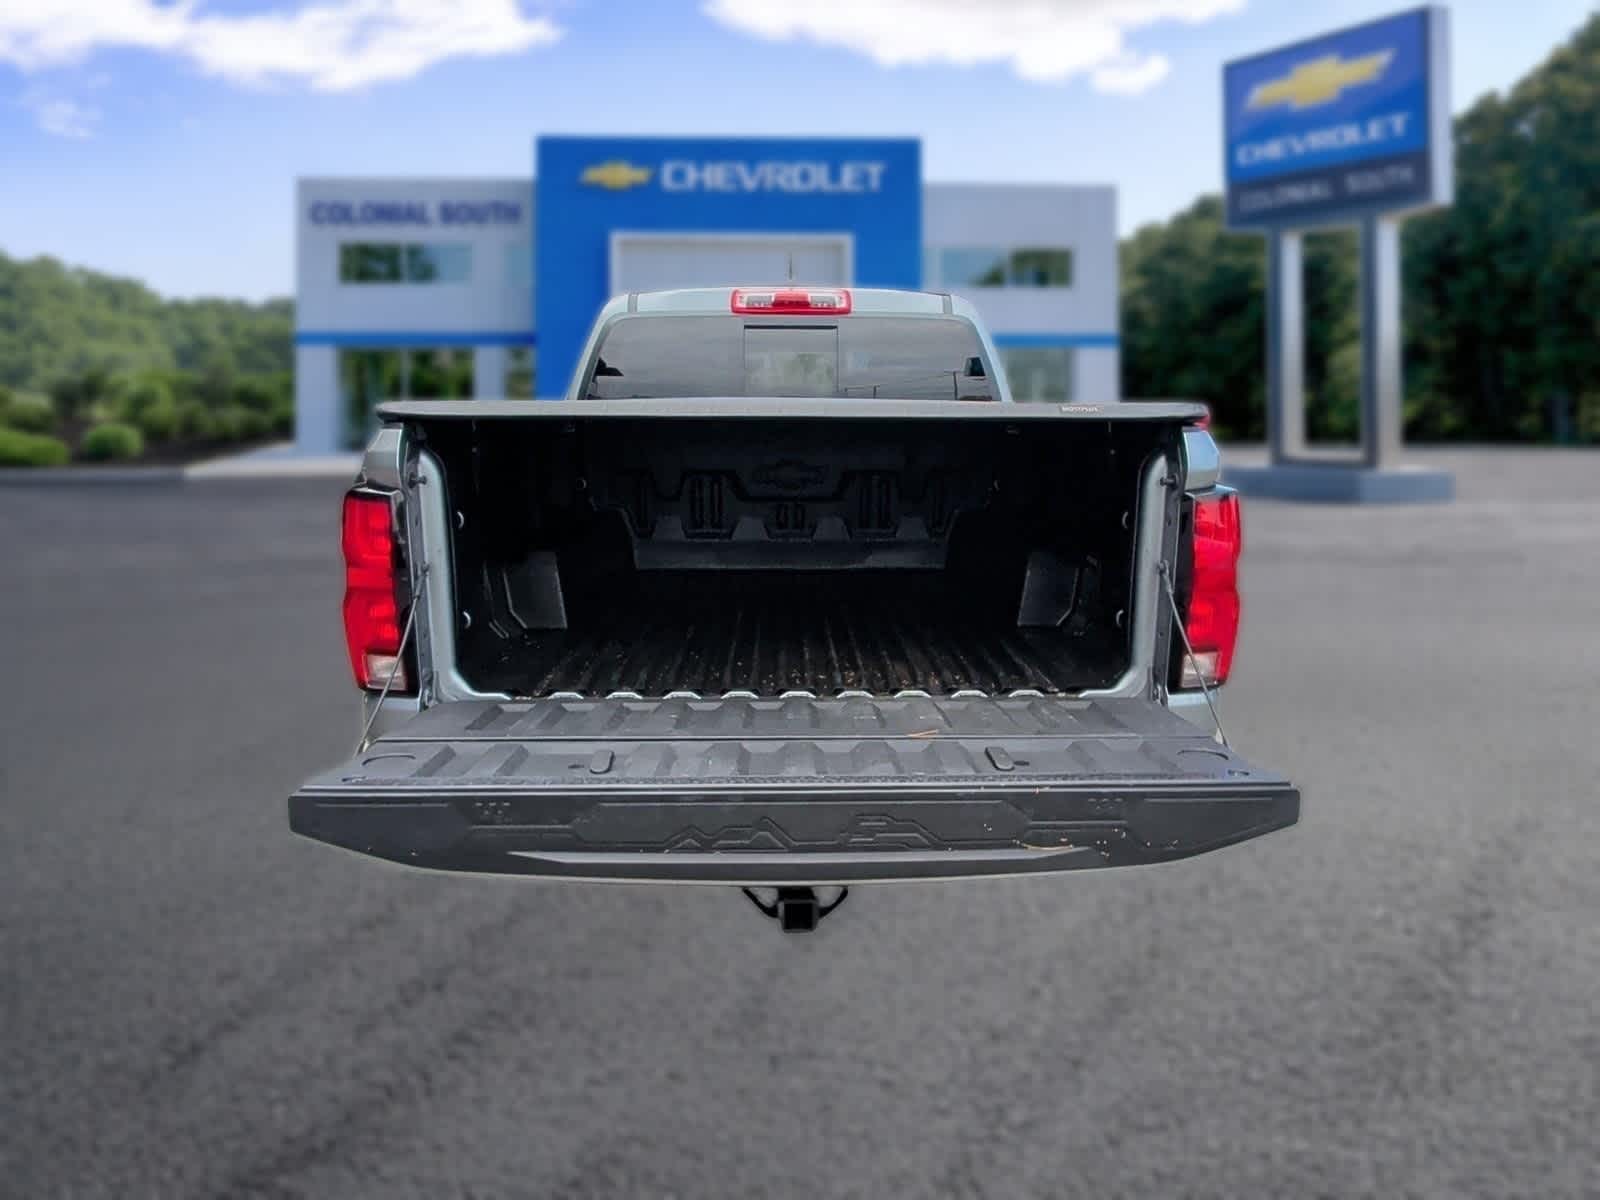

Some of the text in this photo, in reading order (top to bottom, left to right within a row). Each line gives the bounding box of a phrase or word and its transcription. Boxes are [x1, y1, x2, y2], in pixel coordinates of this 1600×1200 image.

[1236, 111, 1411, 168] CHEVROLET
[661, 160, 886, 192] CHEVROLET
[309, 200, 523, 226] COLONIAL SOUTH
